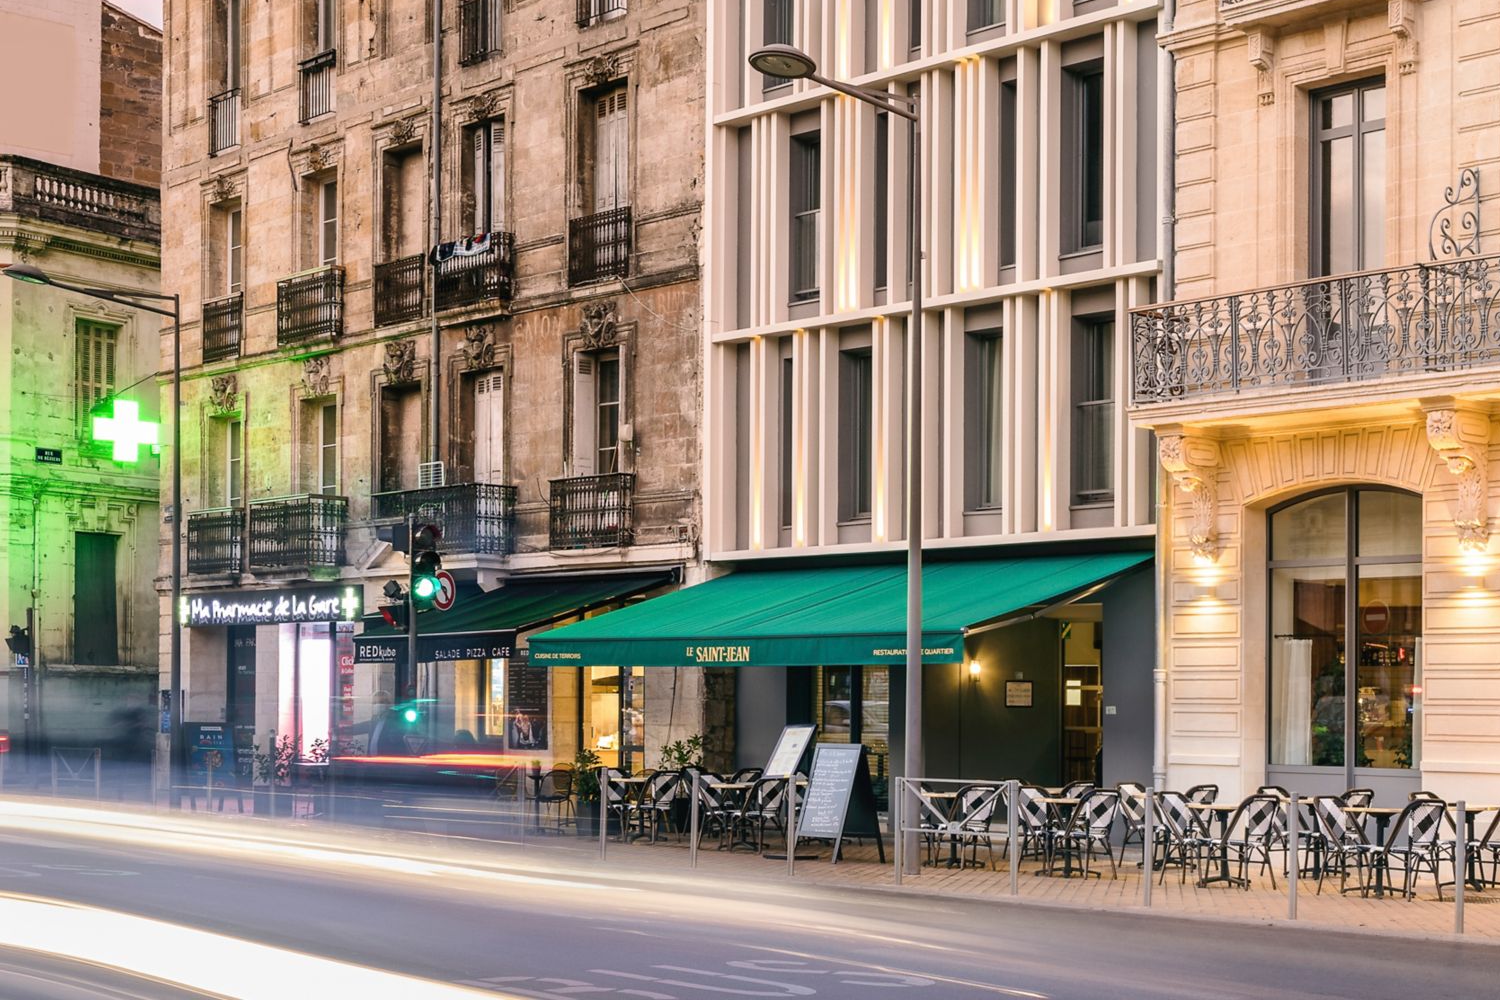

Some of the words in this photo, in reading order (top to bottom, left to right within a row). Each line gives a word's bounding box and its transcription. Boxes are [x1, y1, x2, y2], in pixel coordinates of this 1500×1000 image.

[191, 598, 210, 619] Ma
[212, 598, 273, 618] Pharmacie
[274, 596, 290, 616] de
[308, 595, 341, 615] Gare
[435, 649, 460, 660] SALADE
[467, 648, 486, 658] PIZZA
[491, 647, 510, 657] CAFE
[686, 646, 694, 657] LE
[696, 646, 750, 662] SAINT-JEAN
[924, 648, 954, 656] QUARTIER
